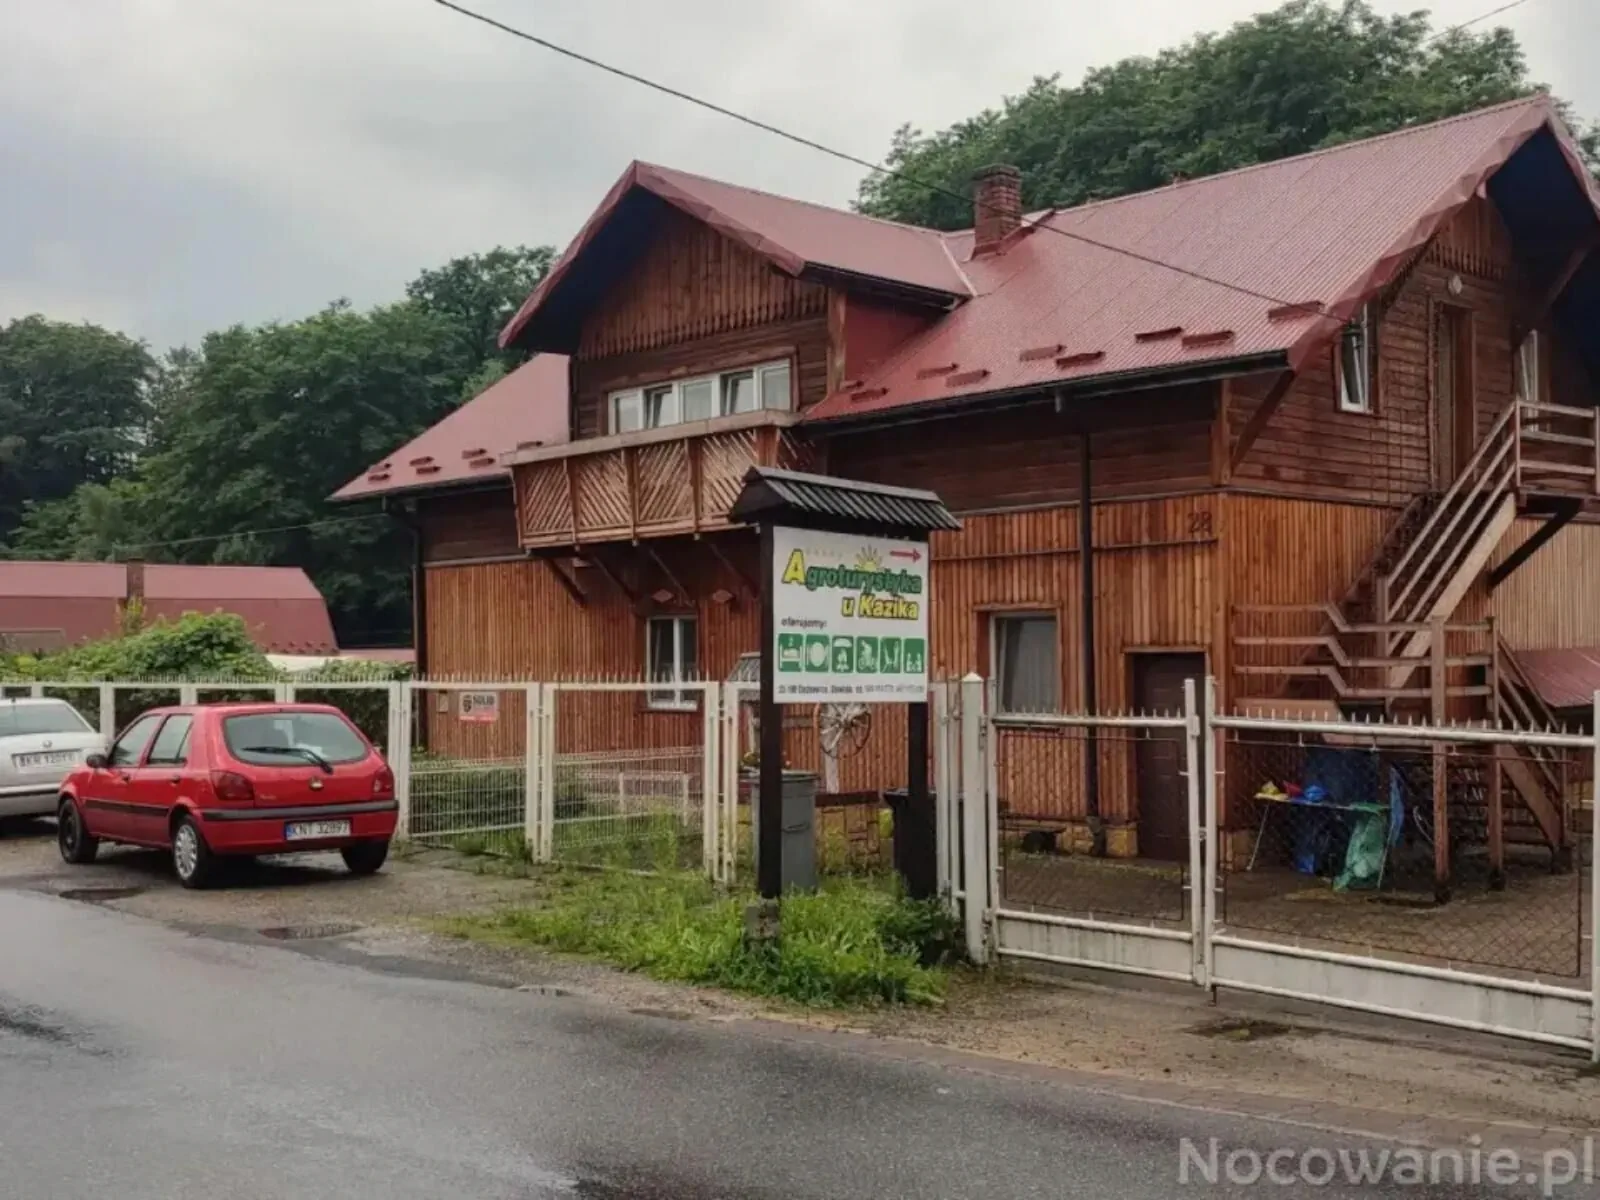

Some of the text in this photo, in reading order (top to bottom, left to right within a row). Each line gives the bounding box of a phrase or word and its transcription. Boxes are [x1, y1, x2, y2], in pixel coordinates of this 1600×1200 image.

[781, 548, 922, 597] Agroturystyka
[841, 593, 920, 620] u Kazika
